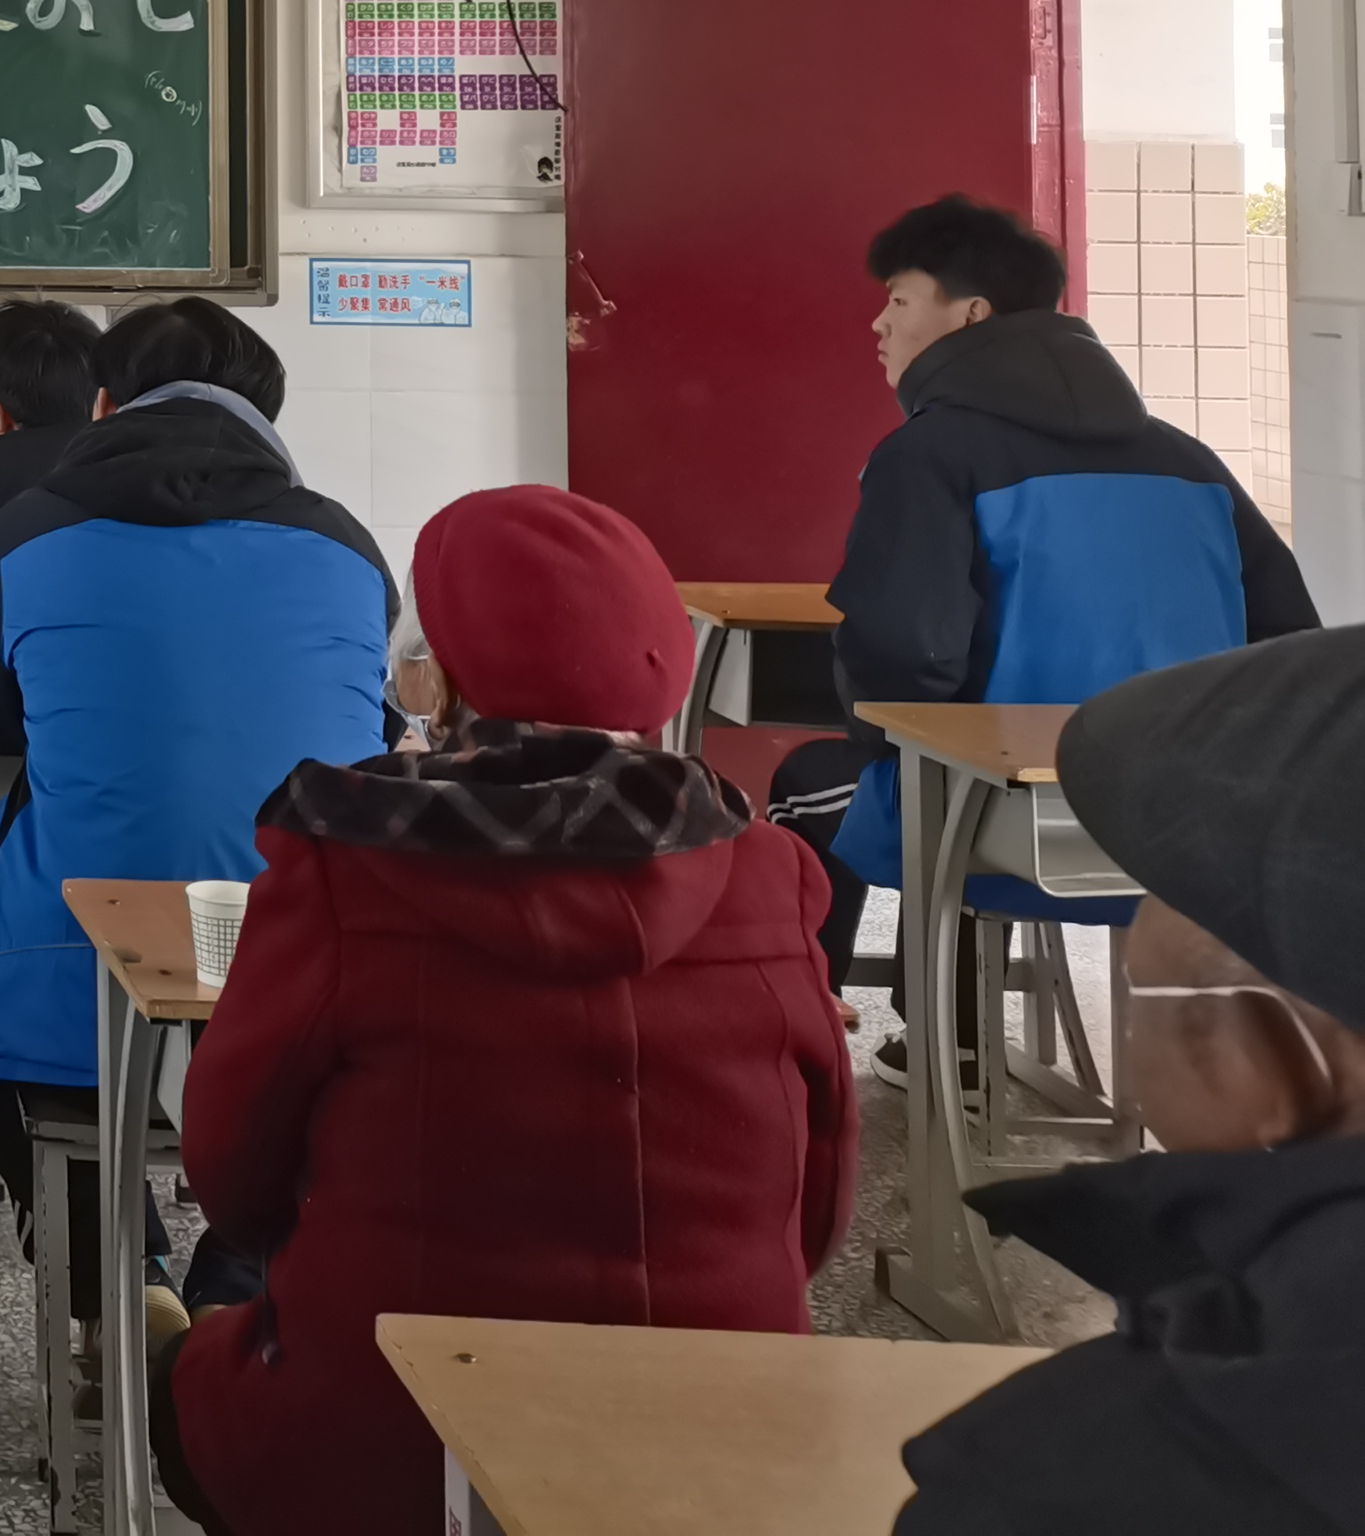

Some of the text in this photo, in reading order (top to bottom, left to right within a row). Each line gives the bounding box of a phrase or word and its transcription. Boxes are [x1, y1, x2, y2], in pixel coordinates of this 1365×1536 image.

[338, 274, 371, 289] 戴口罩
[377, 275, 411, 290] 勤洗手
[338, 297, 411, 312] 少聚集 常通风
